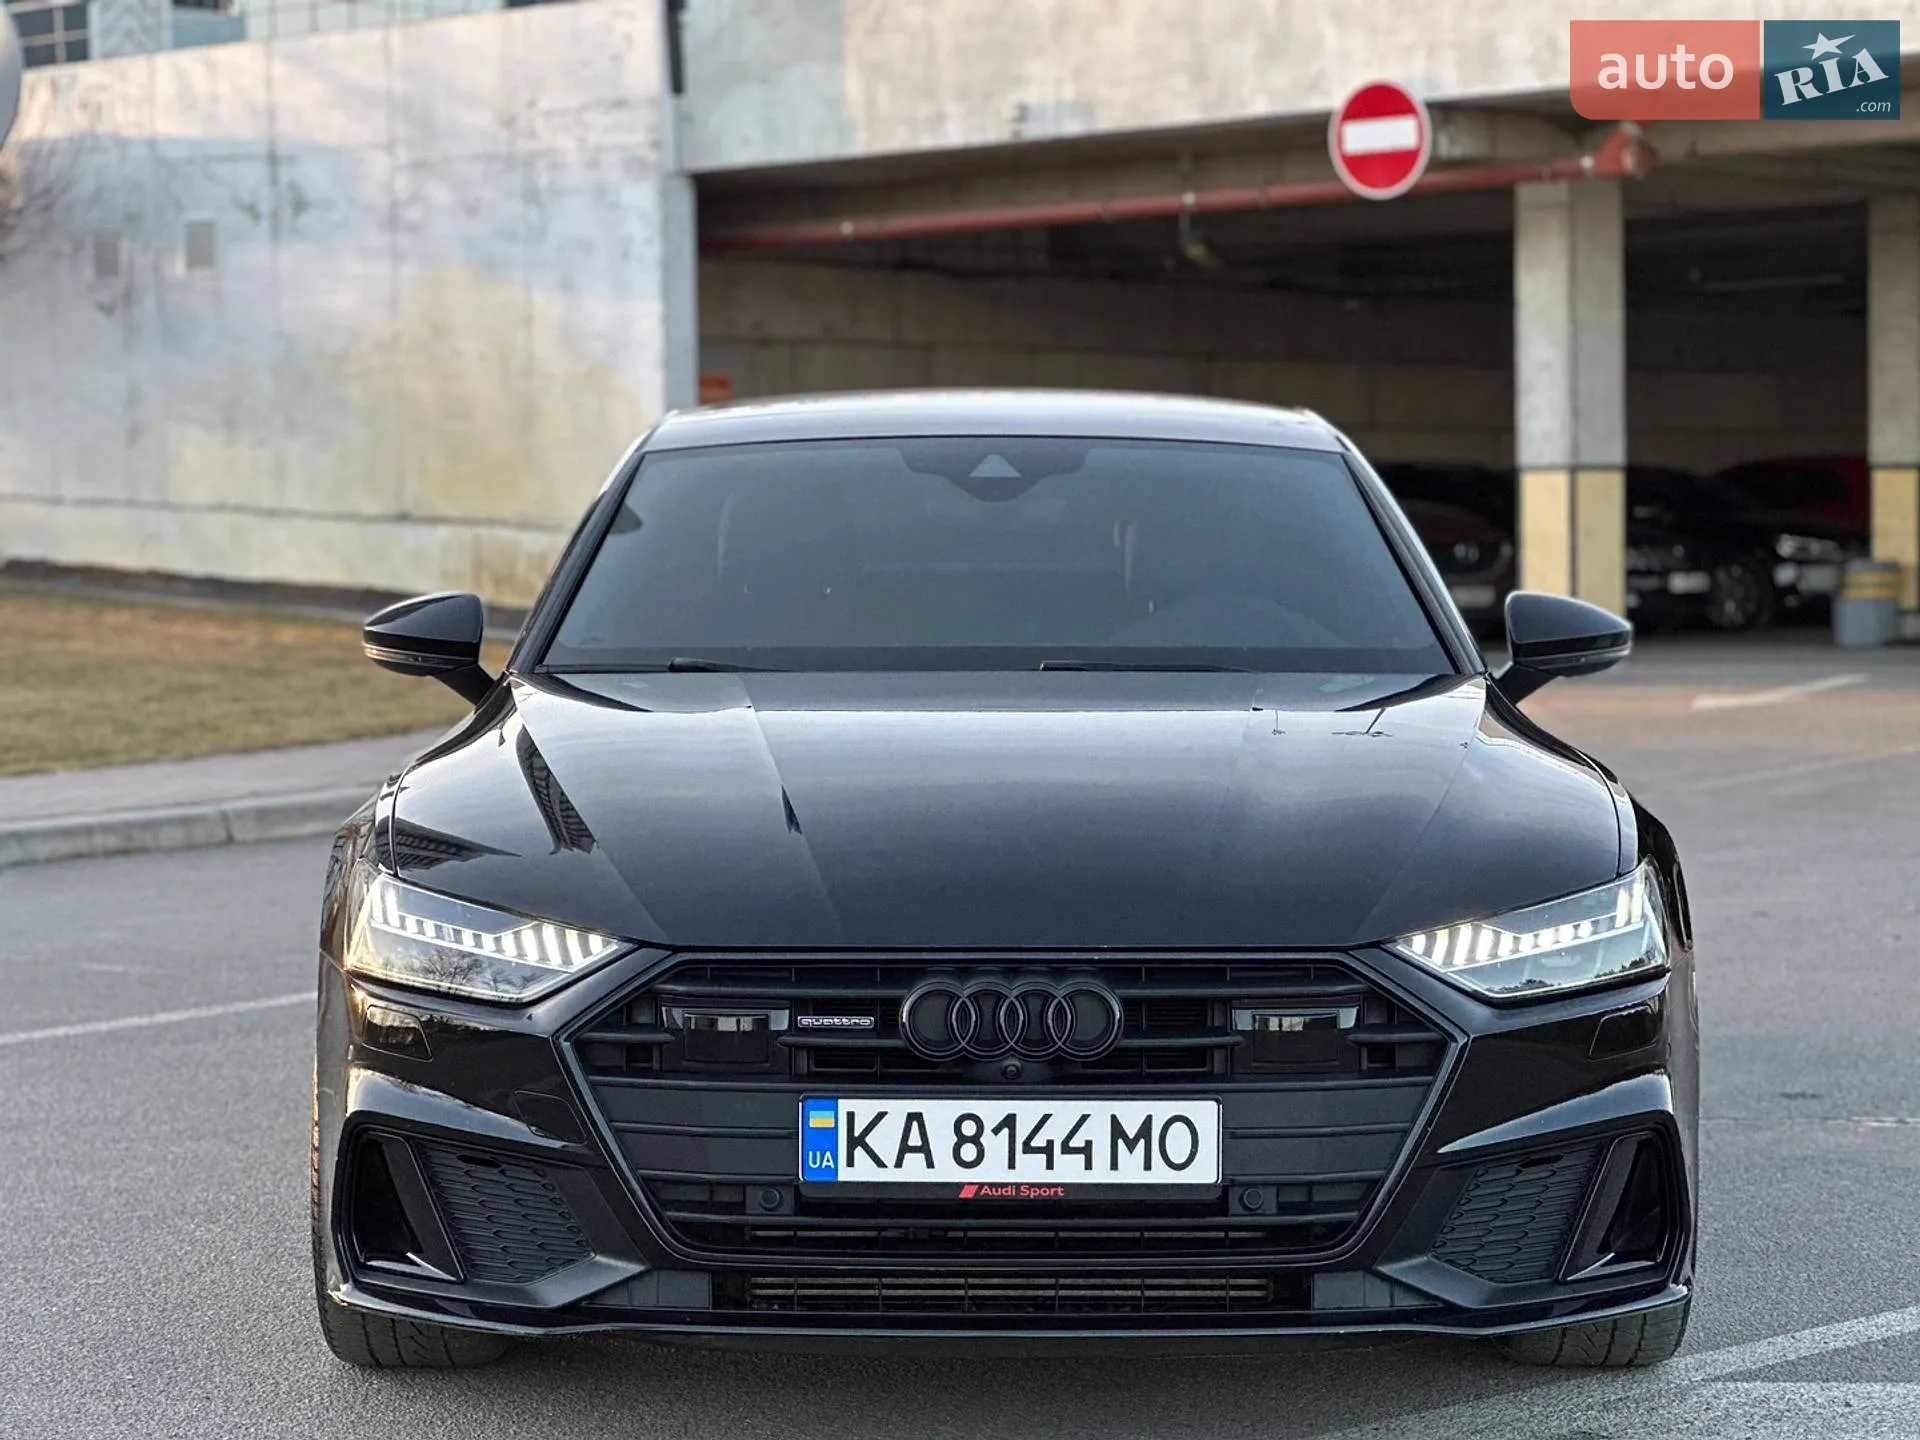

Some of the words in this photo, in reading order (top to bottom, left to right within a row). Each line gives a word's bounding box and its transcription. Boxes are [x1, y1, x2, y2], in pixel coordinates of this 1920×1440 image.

[801, 1018, 871, 1027] quattro
[845, 1110, 936, 1169] KA
[952, 1112, 1093, 1171] 8144
[1110, 1113, 1200, 1172] MO
[808, 1151, 835, 1169] UA
[980, 1185, 1016, 1196] Audi
[1020, 1185, 1065, 1199] Sport
